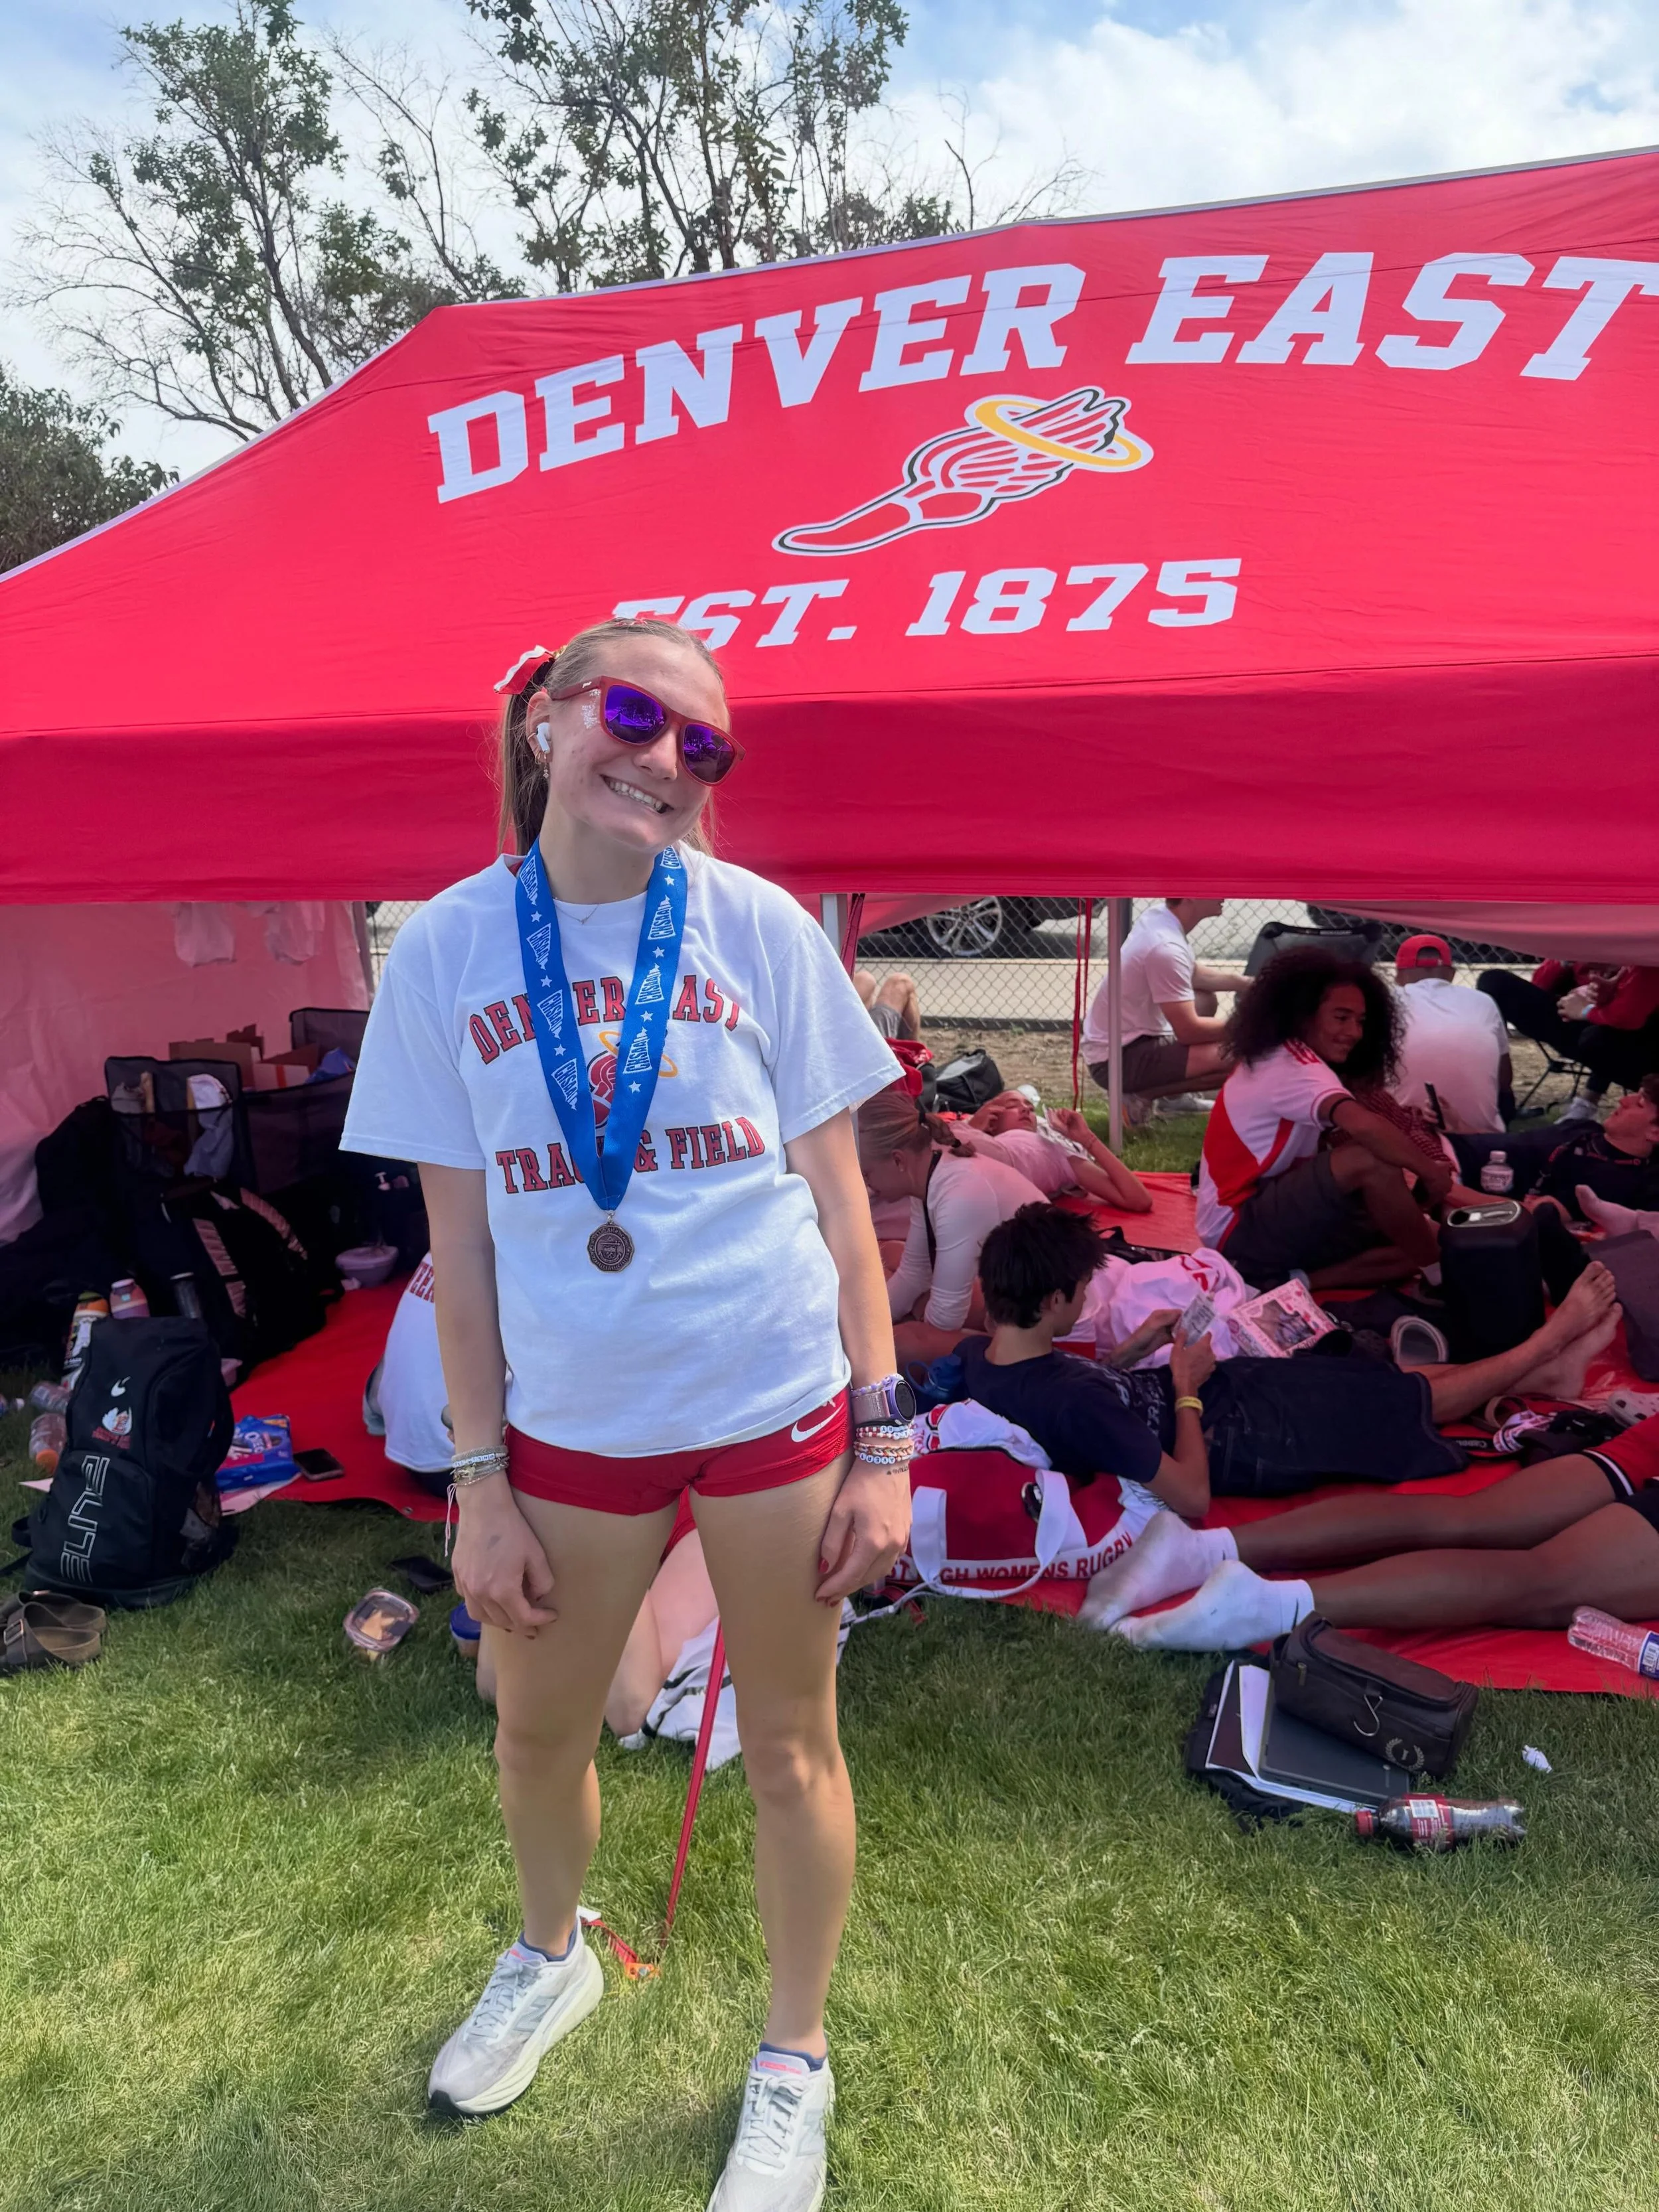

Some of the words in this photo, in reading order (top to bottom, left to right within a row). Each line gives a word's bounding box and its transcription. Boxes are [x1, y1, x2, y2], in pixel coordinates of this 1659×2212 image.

[428, 263, 1086, 504] DENVER
[1125, 252, 1659, 382] EAST
[905, 558, 1242, 636] 1875
[469, 976, 626, 1065] DENER
[495, 1142, 605, 1195] TRA
[633, 1129, 658, 1173] &
[664, 1116, 766, 1171] FIELD
[60, 1455, 111, 1584] ELITE
